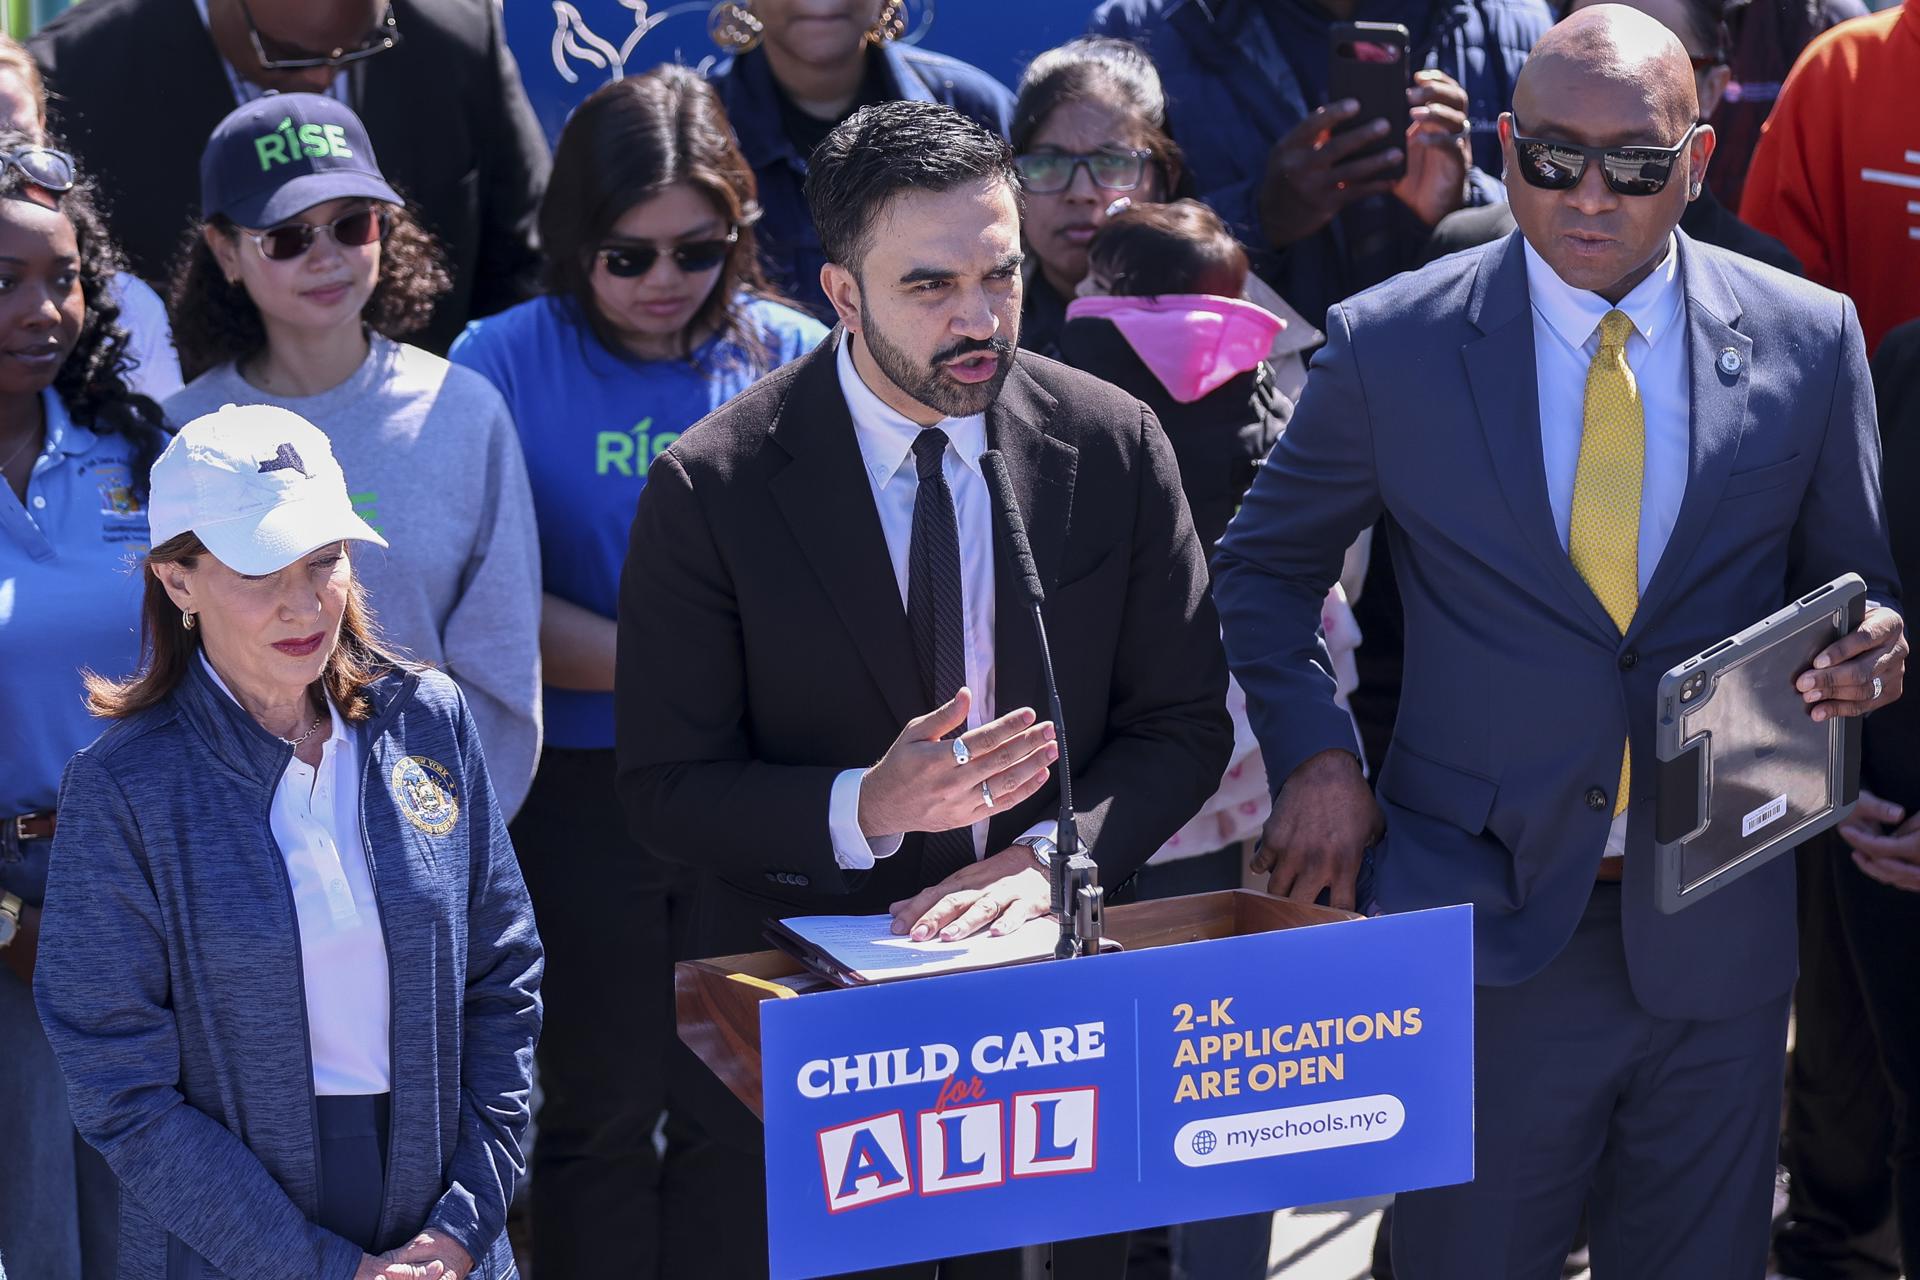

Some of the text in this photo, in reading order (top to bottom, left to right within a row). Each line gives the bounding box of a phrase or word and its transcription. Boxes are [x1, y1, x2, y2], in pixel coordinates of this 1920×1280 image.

[428, 759, 449, 777] YORK
[1172, 997, 1235, 1033] 2-K
[1172, 1007, 1423, 1068] APPLICATIONS
[797, 1021, 1105, 1098] CHILD CARE
[1173, 1053, 1344, 1104] ARE OPEN
[935, 1073, 986, 1114] for
[834, 1099, 1078, 1200] ALL
[1226, 1110, 1388, 1148] myschools.nyc
